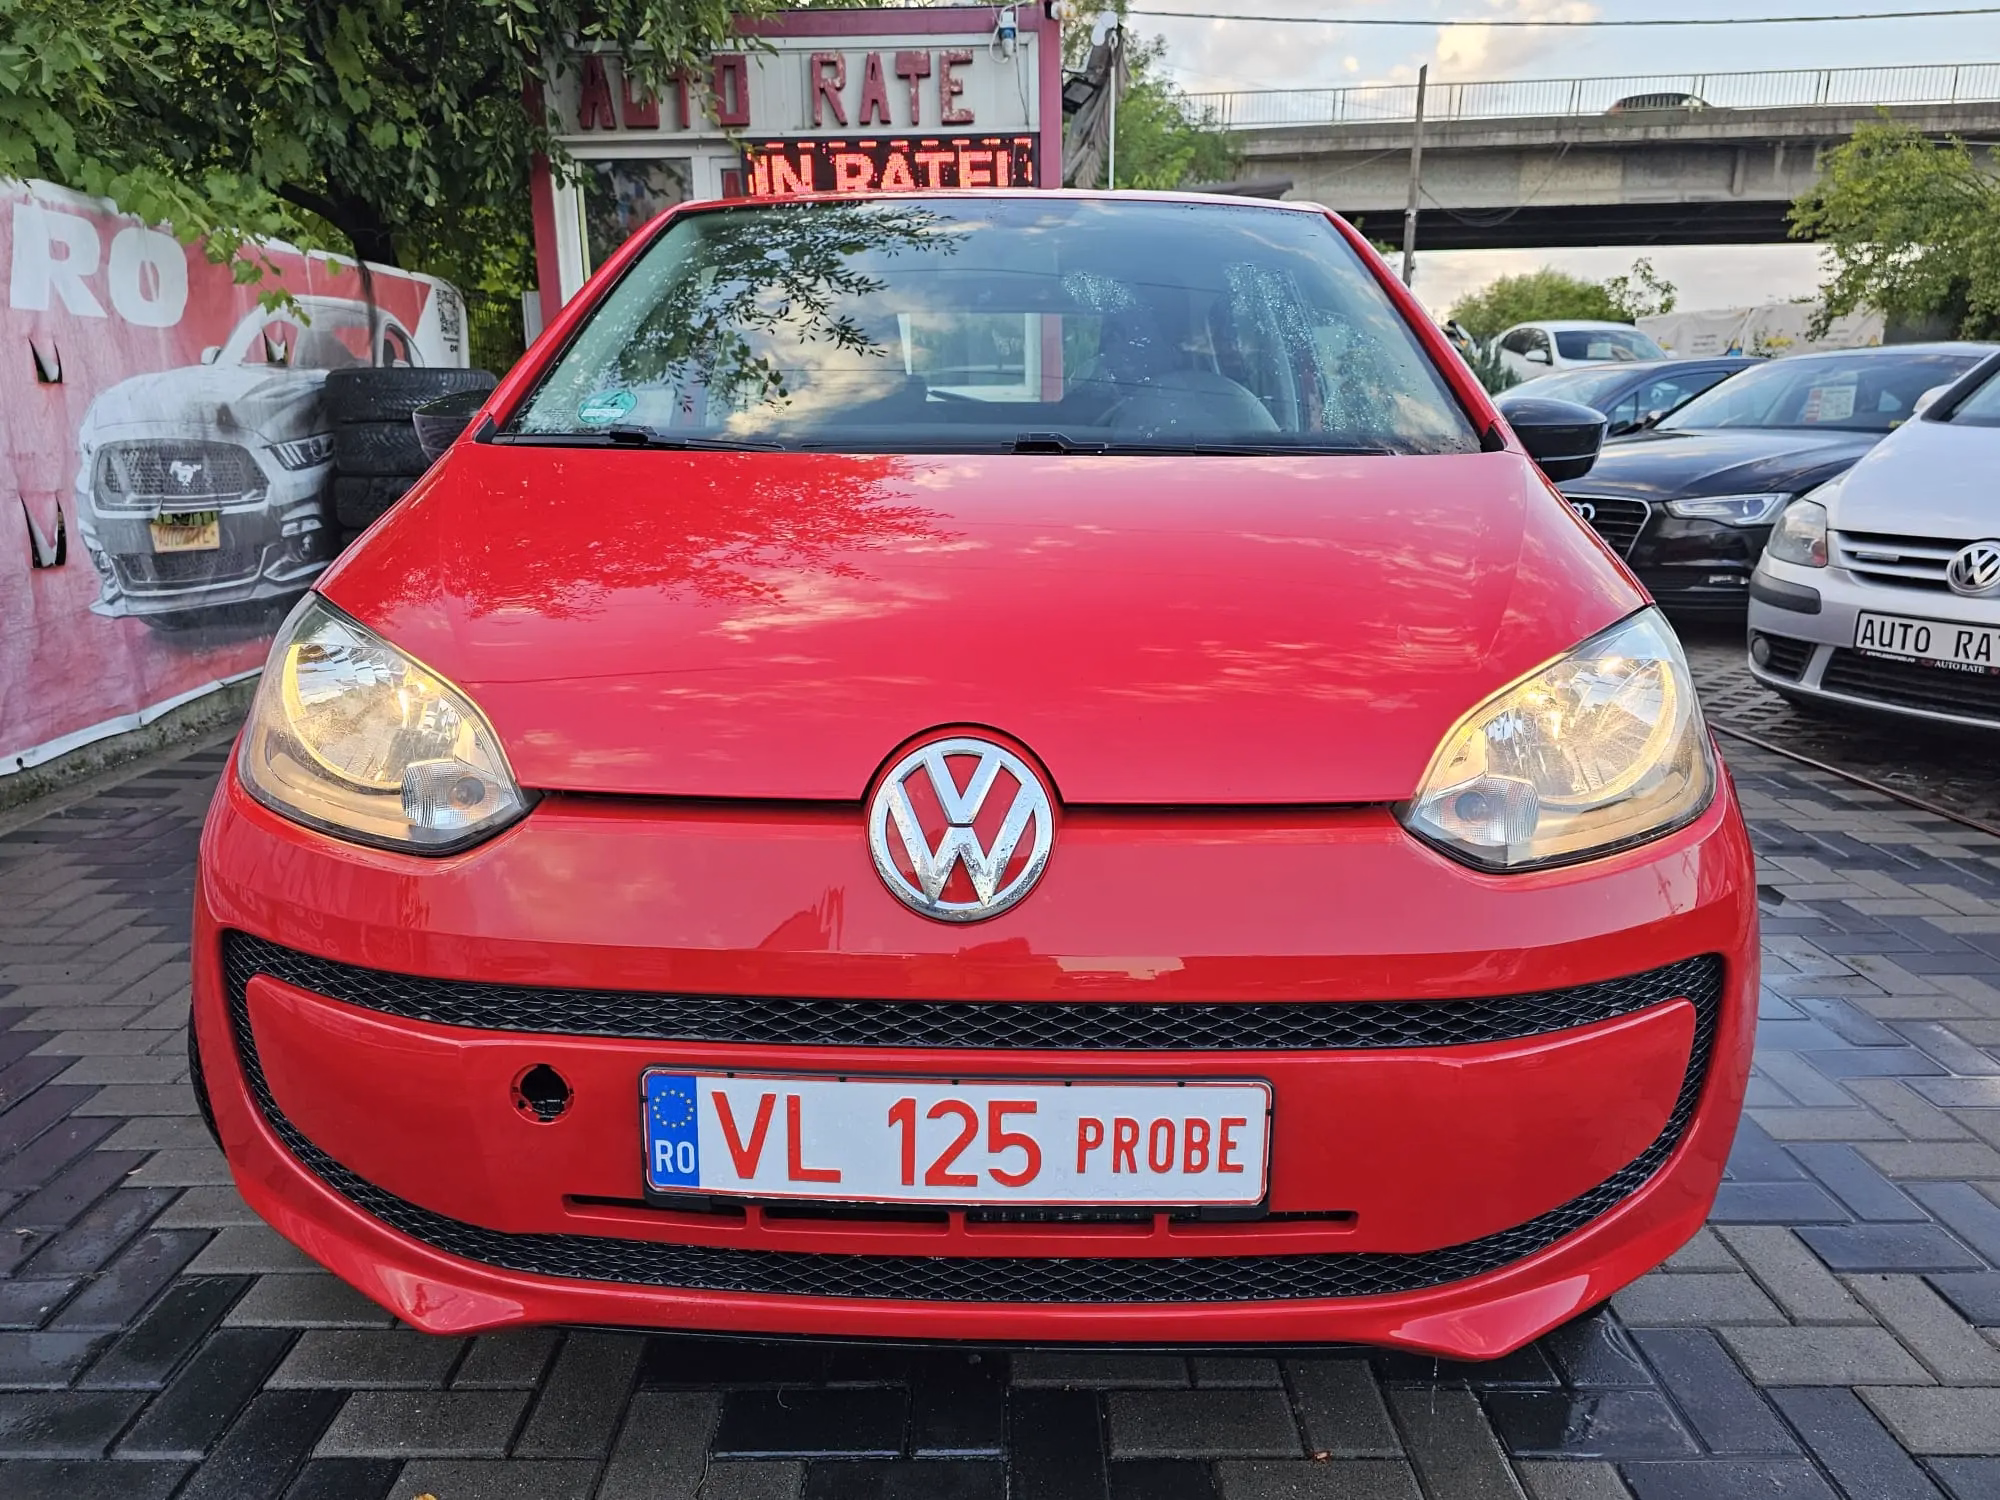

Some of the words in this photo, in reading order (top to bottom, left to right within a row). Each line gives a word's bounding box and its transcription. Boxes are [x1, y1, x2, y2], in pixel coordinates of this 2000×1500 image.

[811, 49, 975, 126] RATE
[754, 154, 814, 197] IN
[10, 203, 189, 328] RO
[1861, 619, 1931, 653] AUTO
[1954, 630, 2000, 662] RA
[1934, 660, 1960, 670] AUTO
[1961, 662, 1985, 674] RATE
[655, 1139, 695, 1175] RO
[711, 1090, 842, 1184] VL
[887, 1097, 1042, 1188] 125
[1076, 1116, 1249, 1175] PROBE
